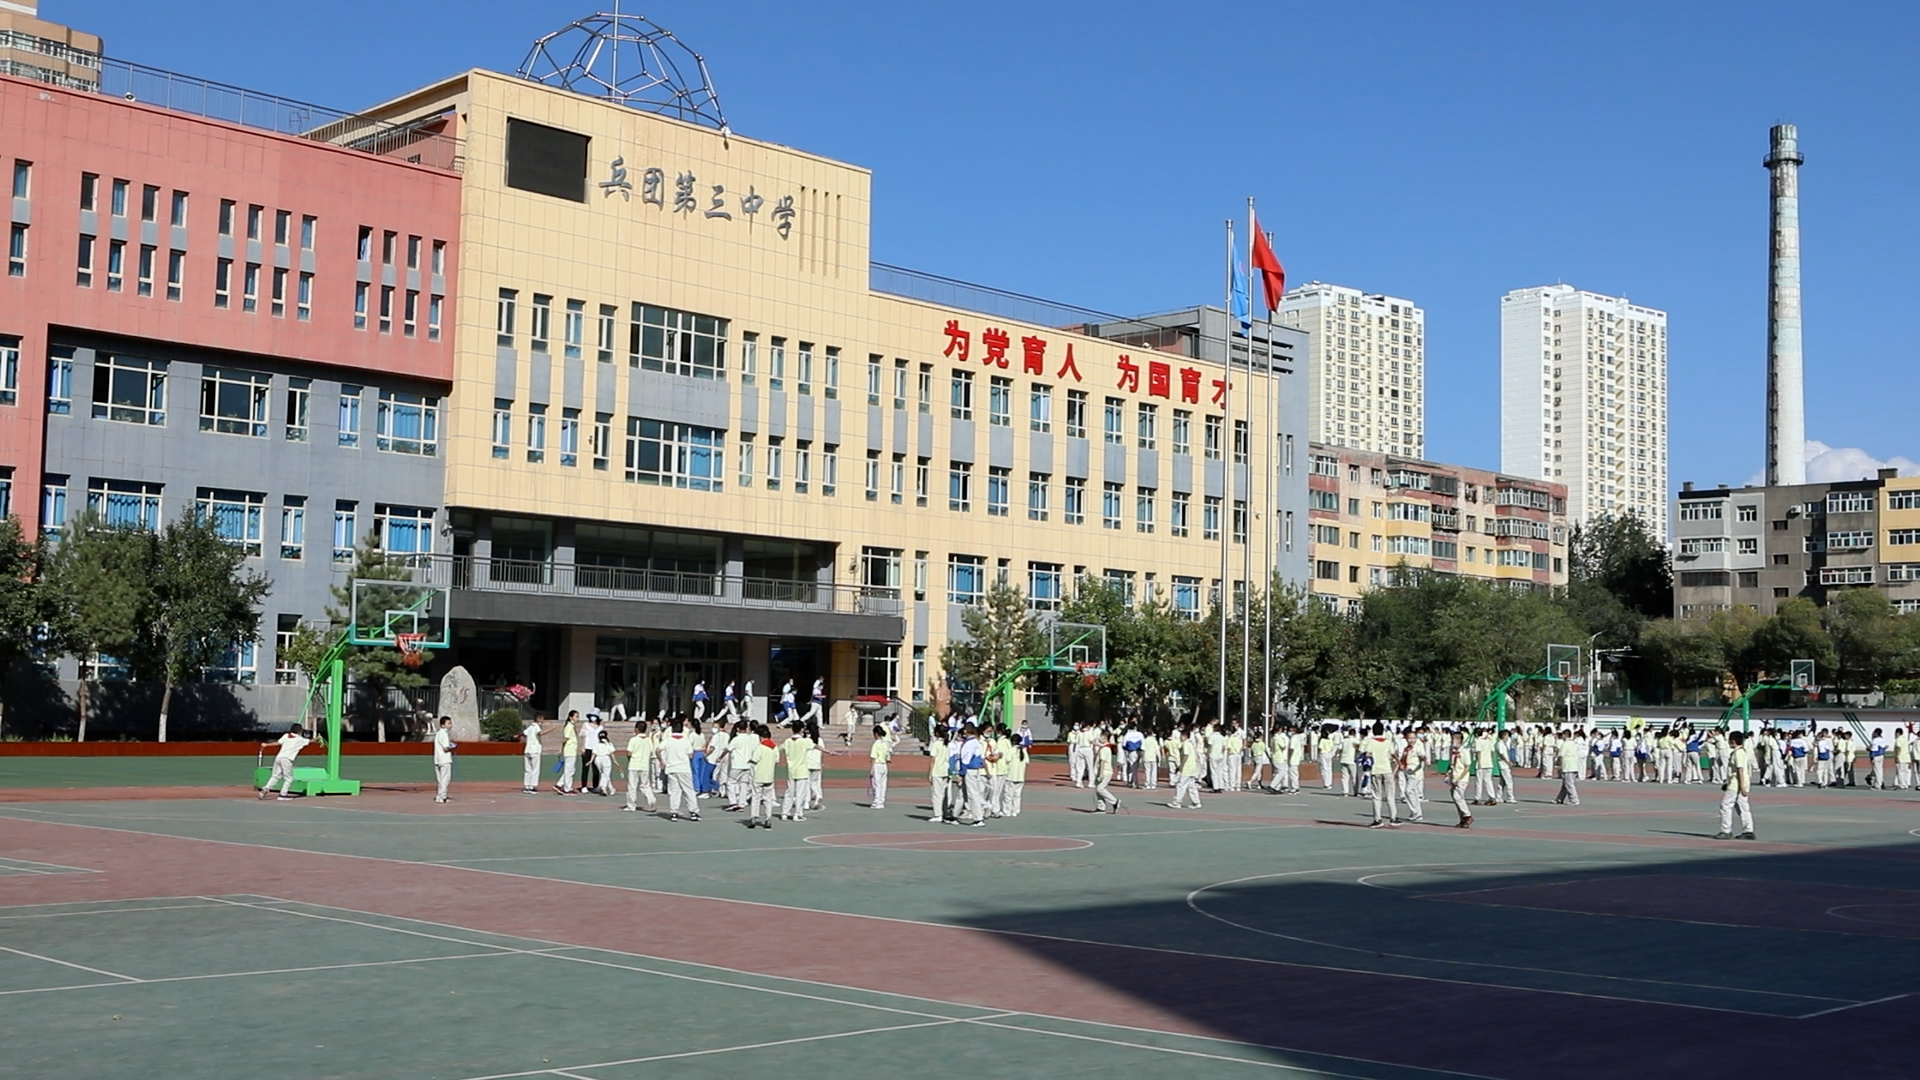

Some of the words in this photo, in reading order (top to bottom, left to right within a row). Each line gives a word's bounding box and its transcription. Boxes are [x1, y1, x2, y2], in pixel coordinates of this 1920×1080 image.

[598, 155, 796, 240] 兵团第三中学
[944, 319, 1083, 382] 为党育人
[1117, 354, 1233, 410] 为国育才
